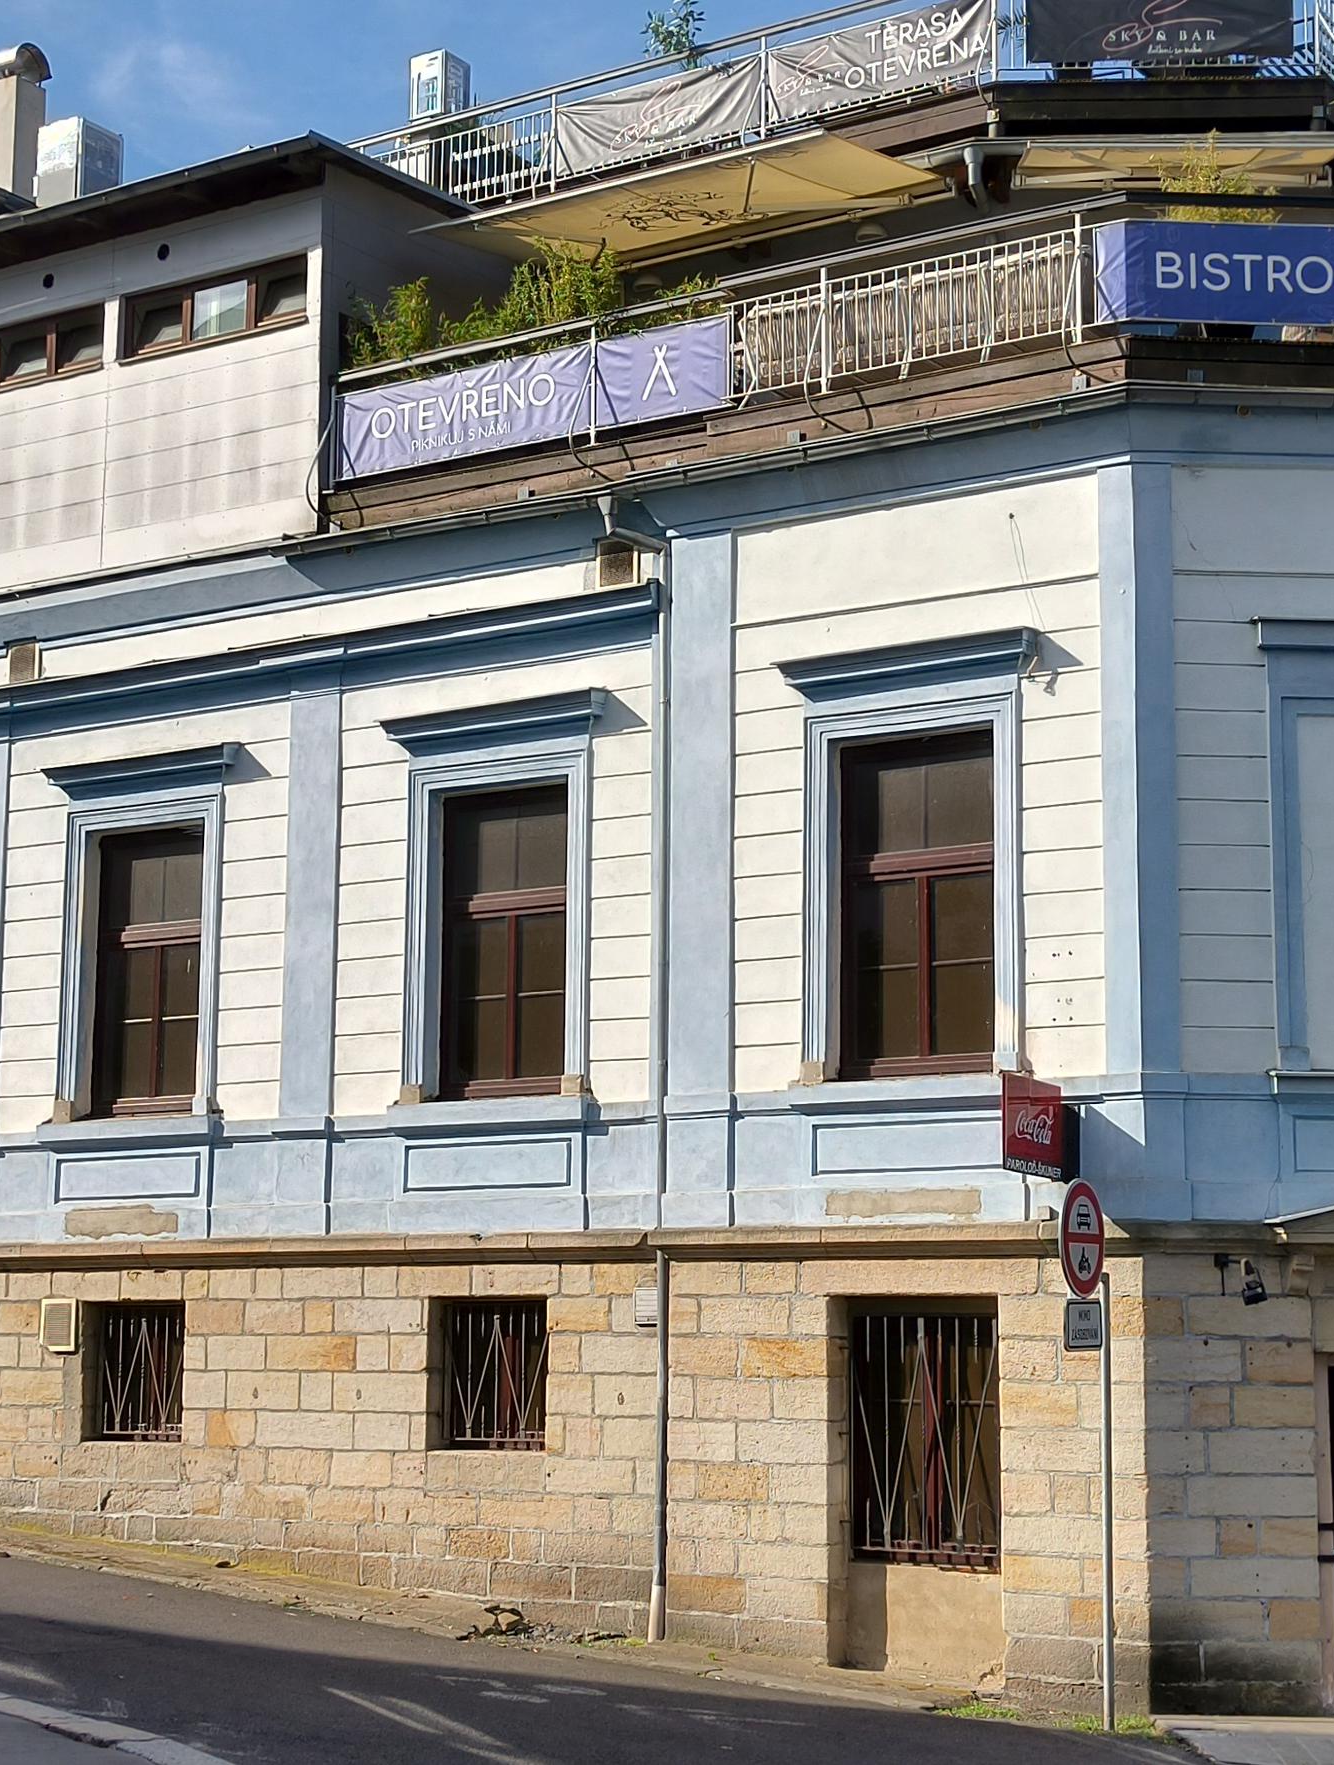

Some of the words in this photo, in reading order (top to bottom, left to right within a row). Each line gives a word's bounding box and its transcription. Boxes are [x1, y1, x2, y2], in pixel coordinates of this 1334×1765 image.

[865, 8, 965, 53] TERASA
[1109, 30, 1145, 42] SKY
[1179, 29, 1215, 41] BAR
[844, 37, 988, 89] OTEVŘENA
[1156, 251, 1333, 294] BISTRO
[371, 373, 556, 439] OTEVŘENO
[411, 430, 464, 453] PIKNIKUJ
[469, 428, 476, 442] S
[478, 420, 511, 439] NÁMI
